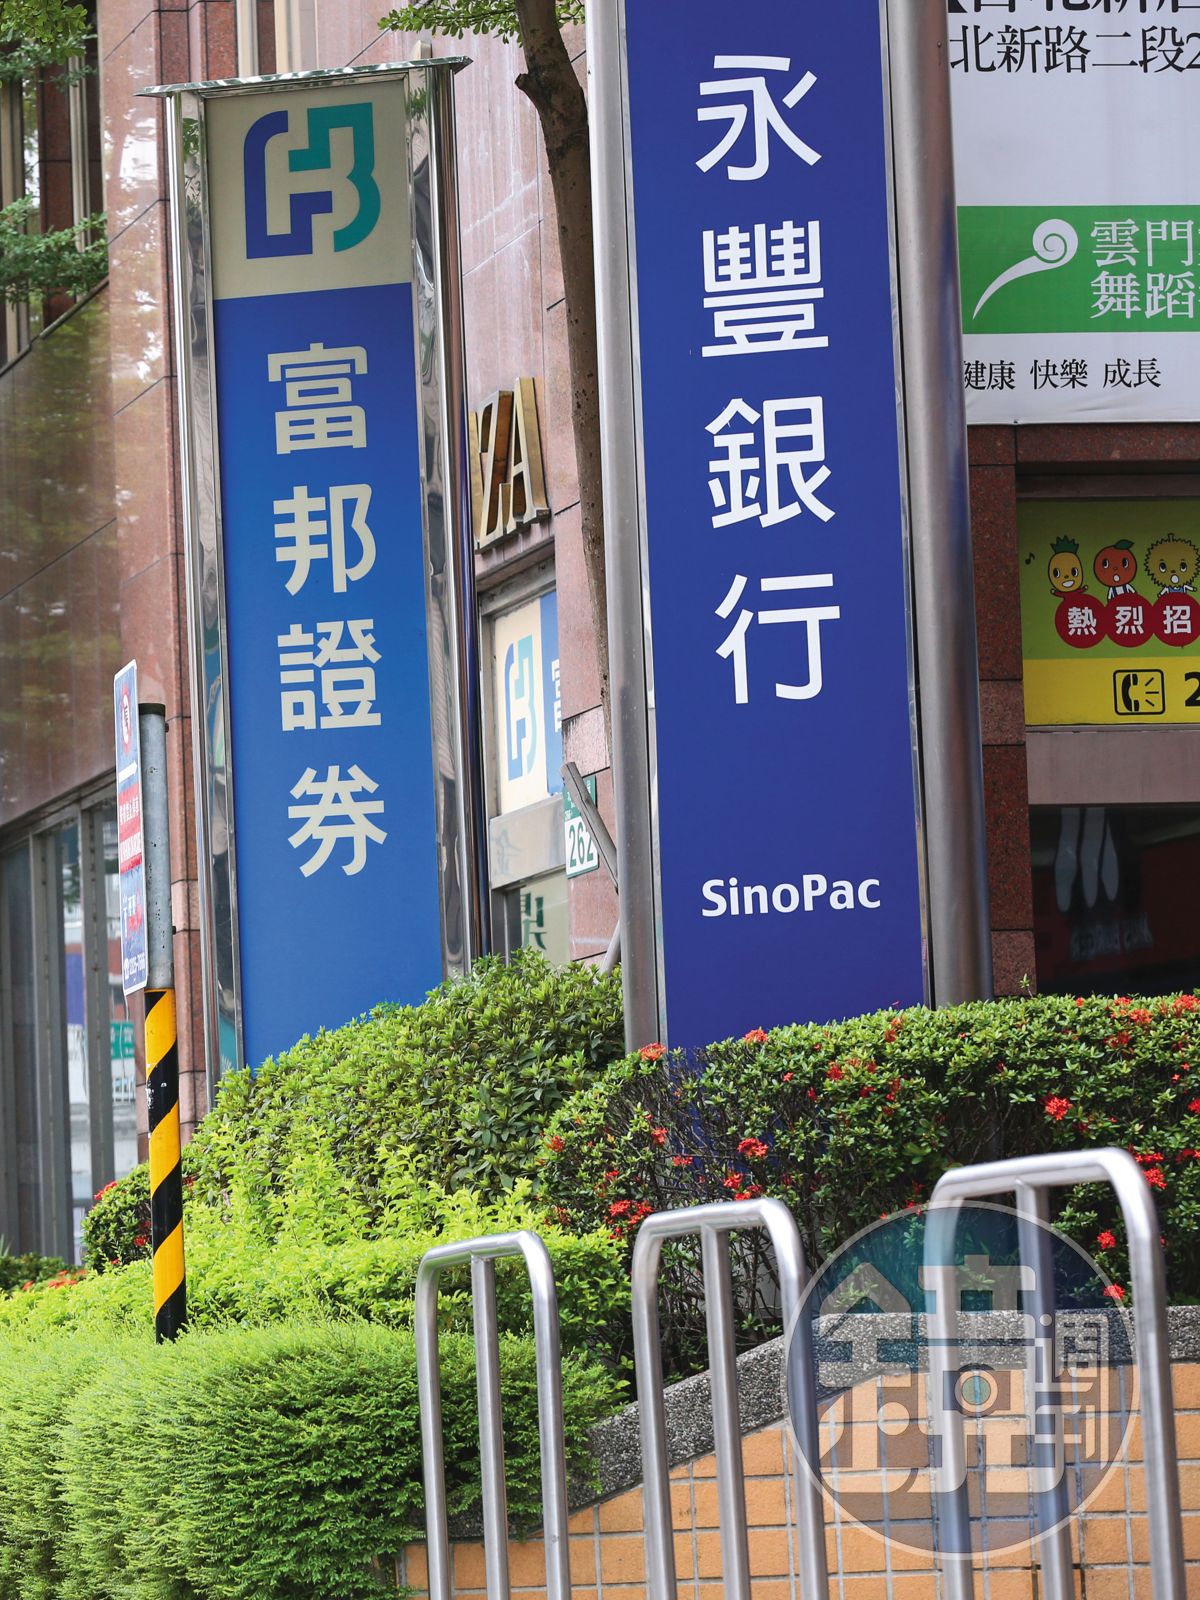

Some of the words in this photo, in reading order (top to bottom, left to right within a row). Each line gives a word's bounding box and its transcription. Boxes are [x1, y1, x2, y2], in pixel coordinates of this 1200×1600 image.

[1090, 218, 1200, 267] 雲門
[1089, 271, 1200, 319] 舞蹈
[695, 55, 840, 704] 永豐銀行
[964, 360, 1016, 390] 健康
[1030, 358, 1088, 389] 快樂
[1103, 358, 1161, 388] 成長
[267, 343, 388, 878] 富邦證券
[1067, 605, 1192, 635] 熱烈招
[701, 874, 881, 917] SinoPac
